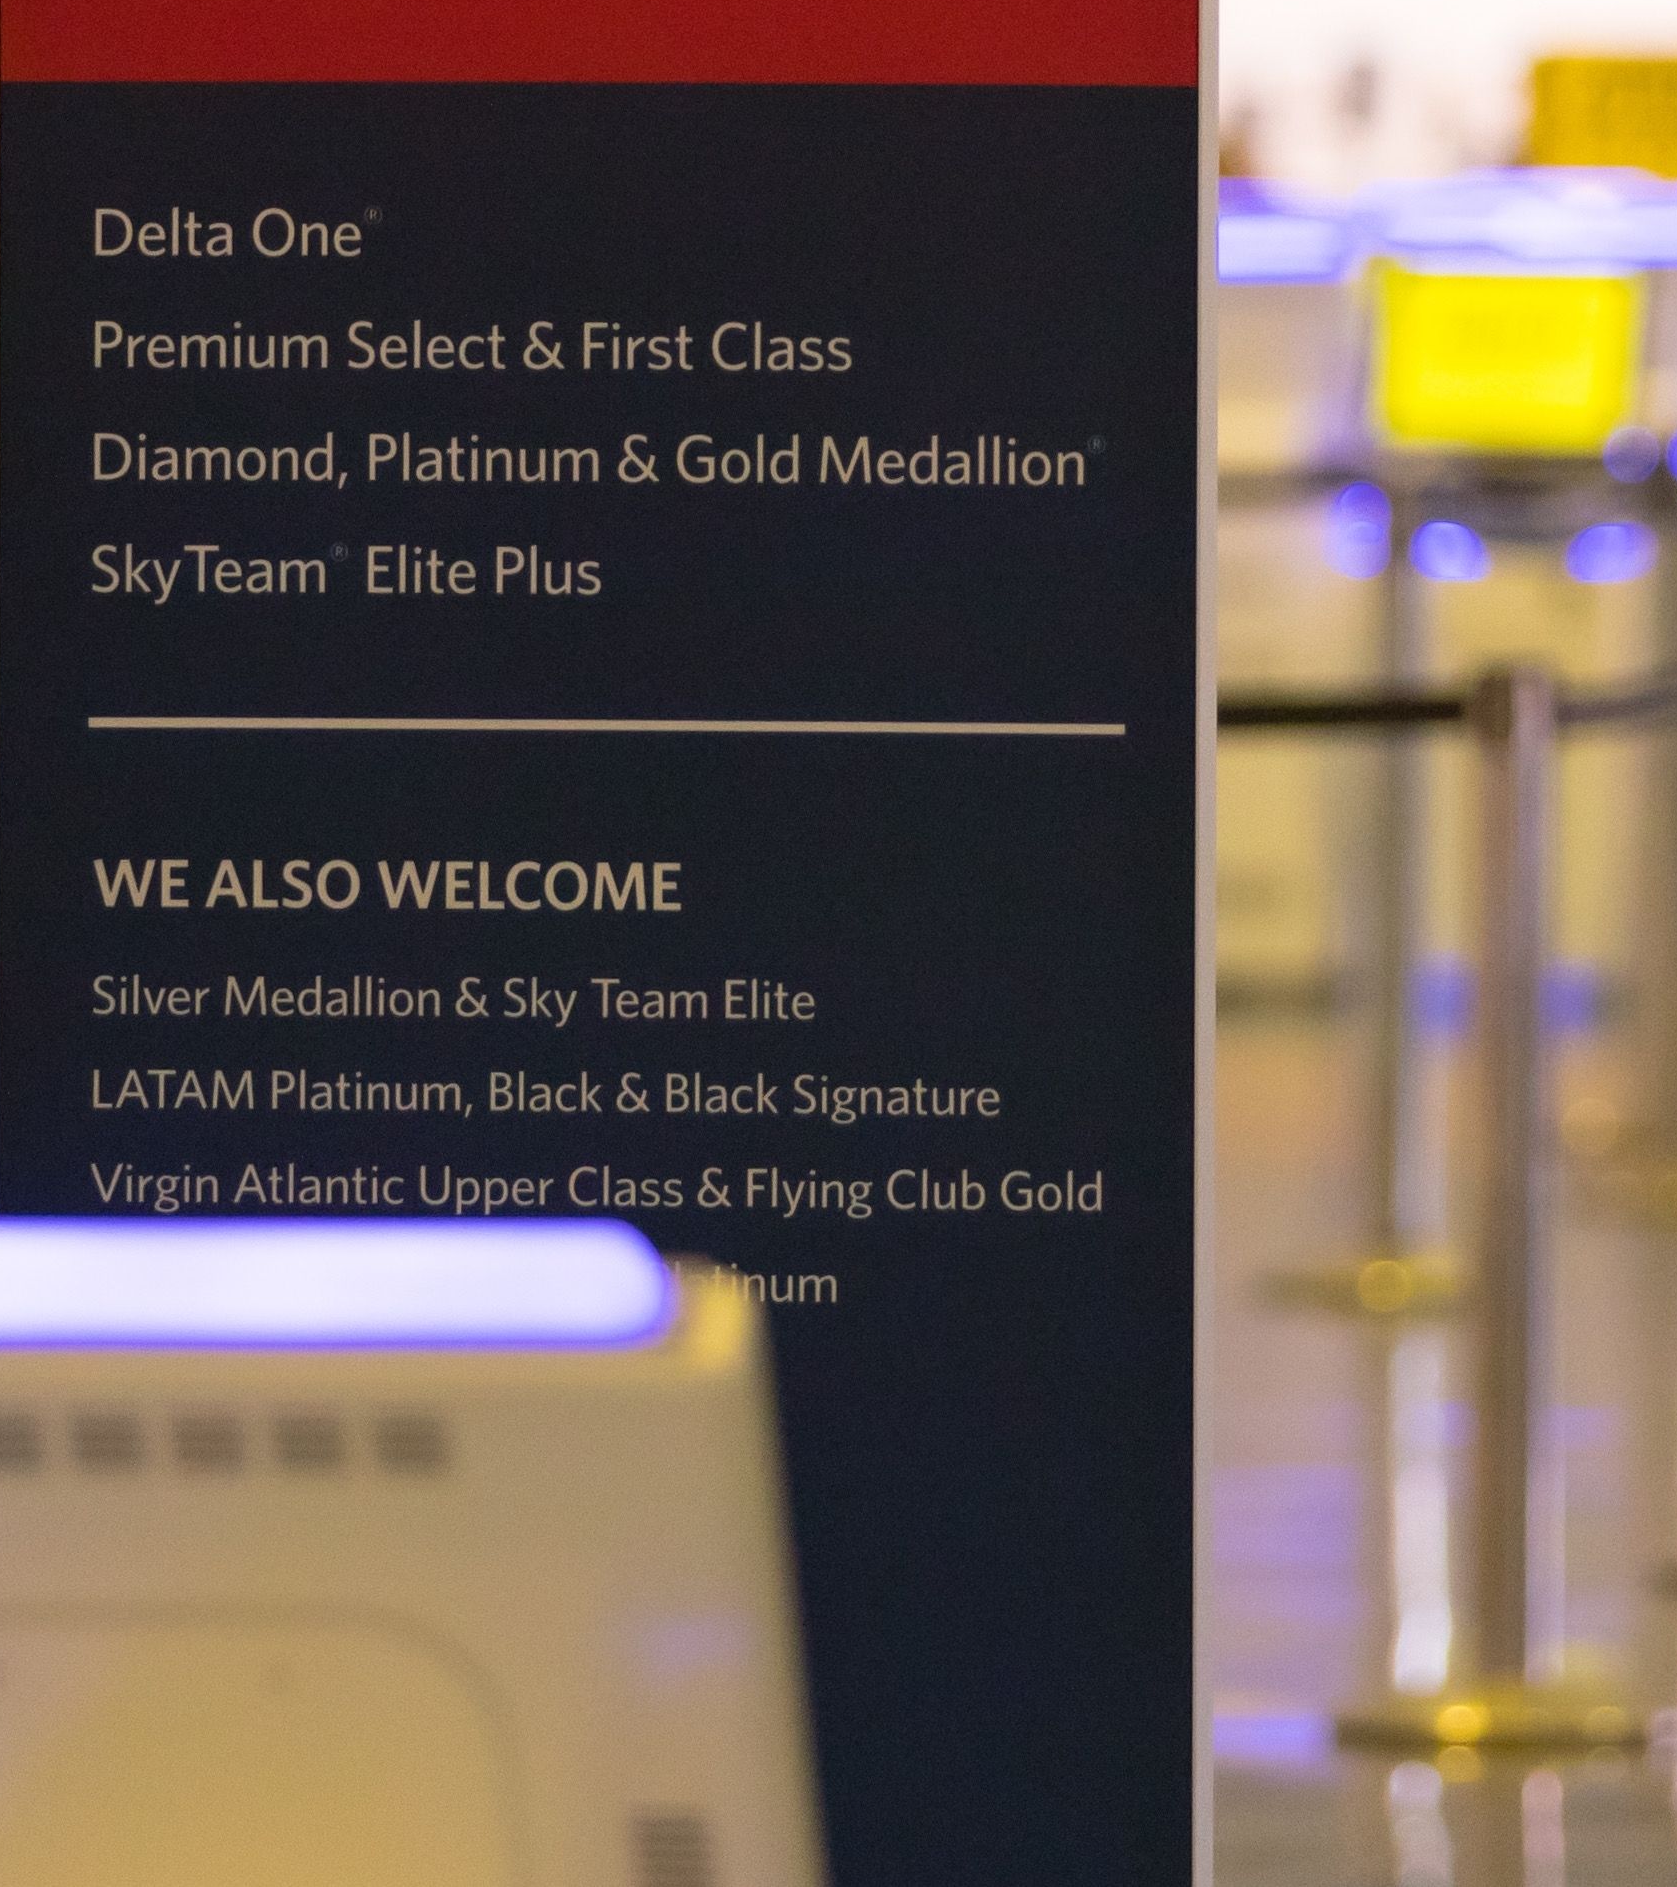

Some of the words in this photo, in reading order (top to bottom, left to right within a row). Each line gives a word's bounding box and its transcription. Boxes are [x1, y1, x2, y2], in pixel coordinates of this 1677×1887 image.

[94, 206, 234, 258] Delta
[94, 320, 329, 370] Premium
[347, 319, 506, 370] Select
[522, 320, 565, 371] &
[582, 321, 694, 371] First
[711, 320, 853, 372] Class
[94, 432, 348, 489] Diamond,
[368, 431, 600, 483] Platinum
[617, 433, 660, 484] &
[675, 433, 800, 485] Gold
[366, 543, 477, 595] Elite
[495, 544, 602, 596] Plus
[93, 858, 190, 908] WE
[205, 859, 361, 910] ALSO
[377, 860, 682, 912] WELCOME
[92, 973, 210, 1016] Silver
[224, 975, 441, 1018] Medallion
[454, 976, 490, 1018] &
[503, 976, 578, 1028] Sky
[590, 977, 708, 1020] Team
[724, 977, 816, 1021] Elite
[92, 1068, 255, 1110] LATAM
[271, 1068, 473, 1118] Platinum,
[489, 1070, 602, 1113] Black
[615, 1071, 650, 1114] &
[665, 1071, 778, 1115] Black
[793, 1073, 1001, 1125] Signature
[90, 1163, 219, 1214] Virgin
[233, 1162, 404, 1206] Atlantic
[419, 1165, 554, 1217] Upper
[567, 1165, 684, 1208] Class
[696, 1166, 732, 1209] &
[746, 1166, 873, 1217] Flying
[886, 1168, 987, 1211] Club
[999, 1169, 1103, 1212] Gold
